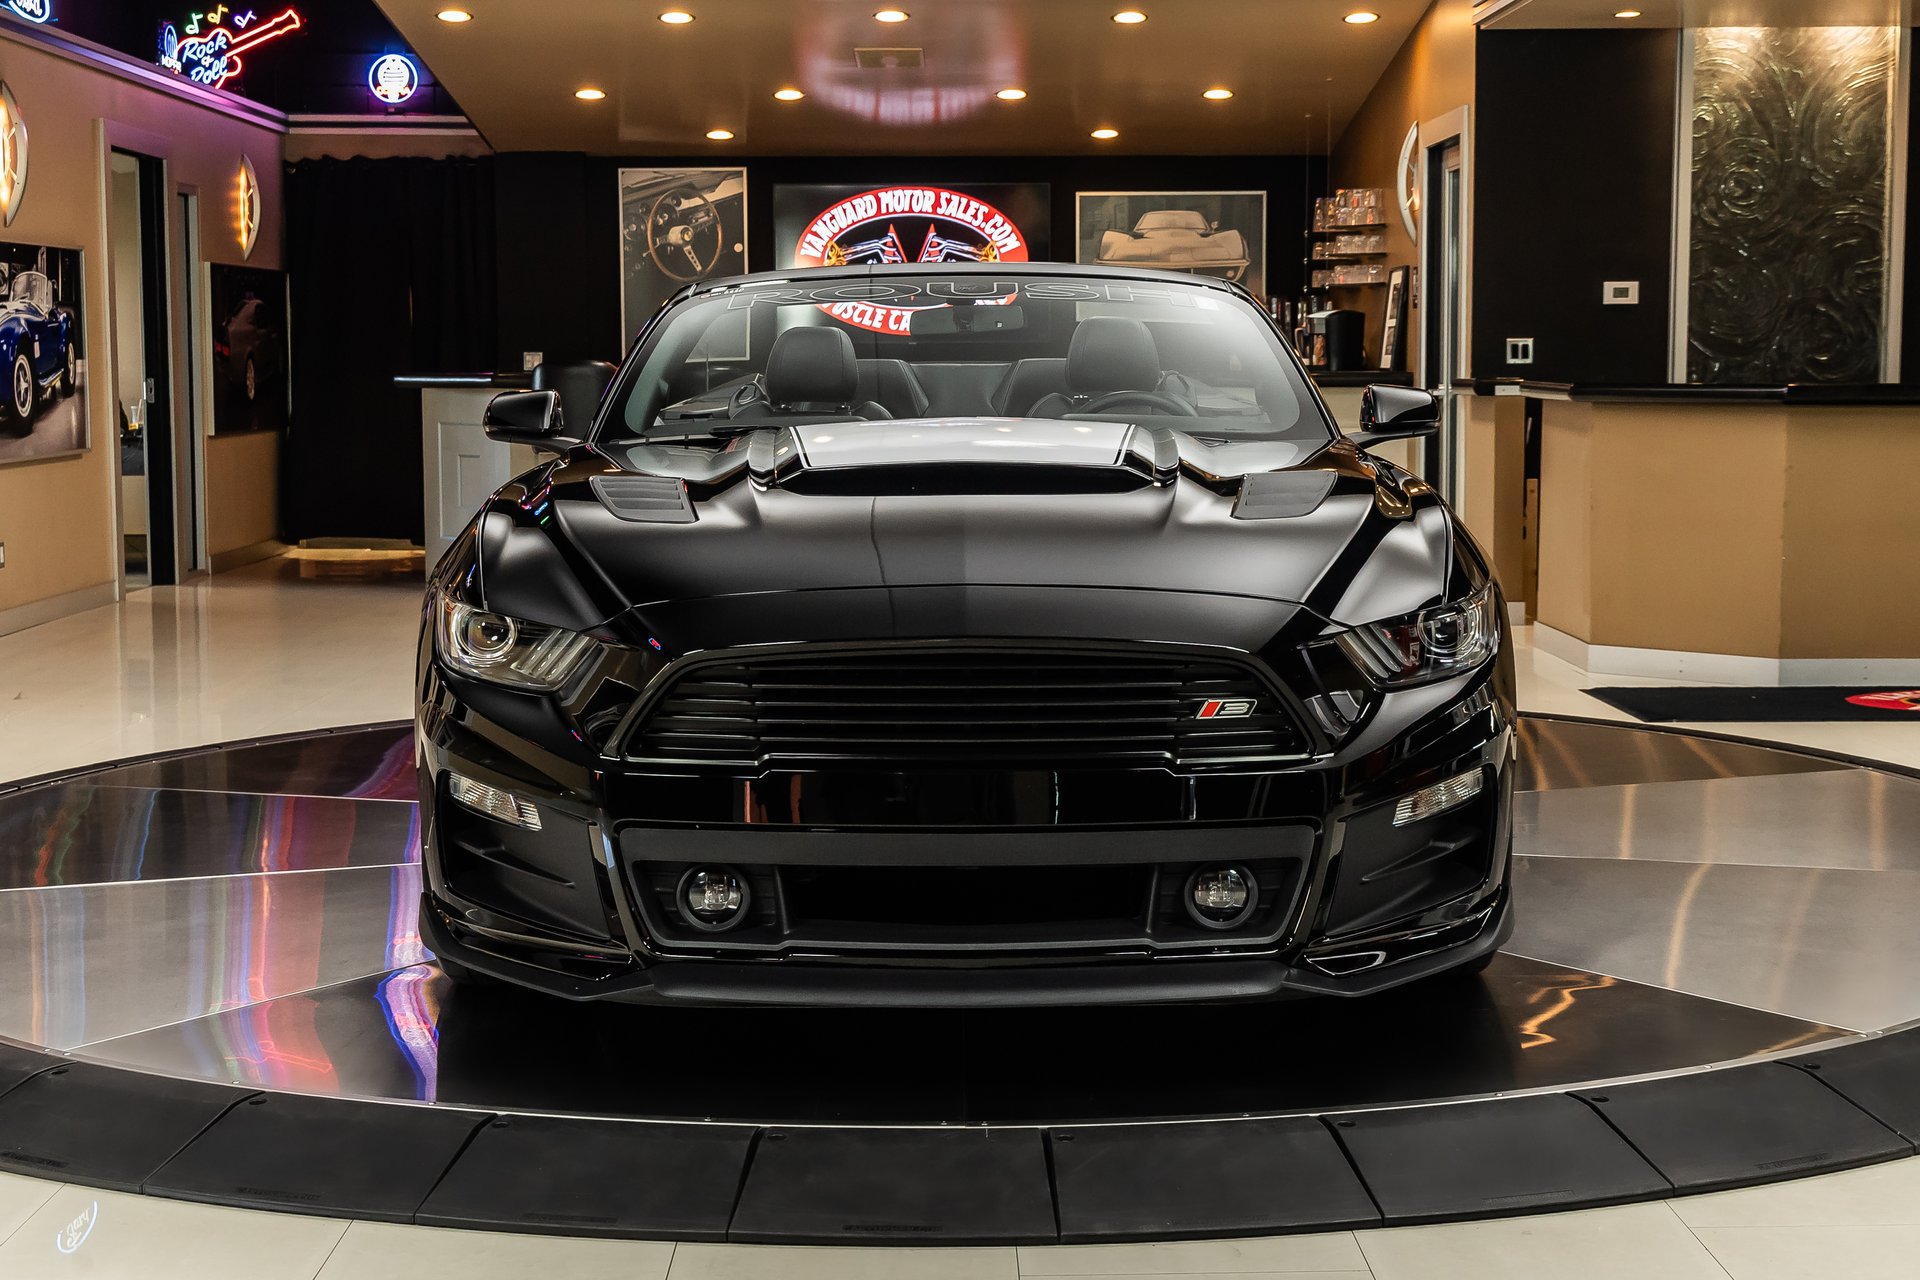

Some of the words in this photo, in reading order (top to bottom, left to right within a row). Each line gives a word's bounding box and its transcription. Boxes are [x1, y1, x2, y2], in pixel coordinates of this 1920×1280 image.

[182, 31, 228, 63] Rock
[800, 194, 877, 258] VANGUARD
[878, 189, 935, 214] MOTOR
[936, 190, 1021, 254] SALES.COM
[727, 282, 1197, 310] ROUSH
[821, 302, 887, 329] USCLE
[888, 309, 911, 332] CA
